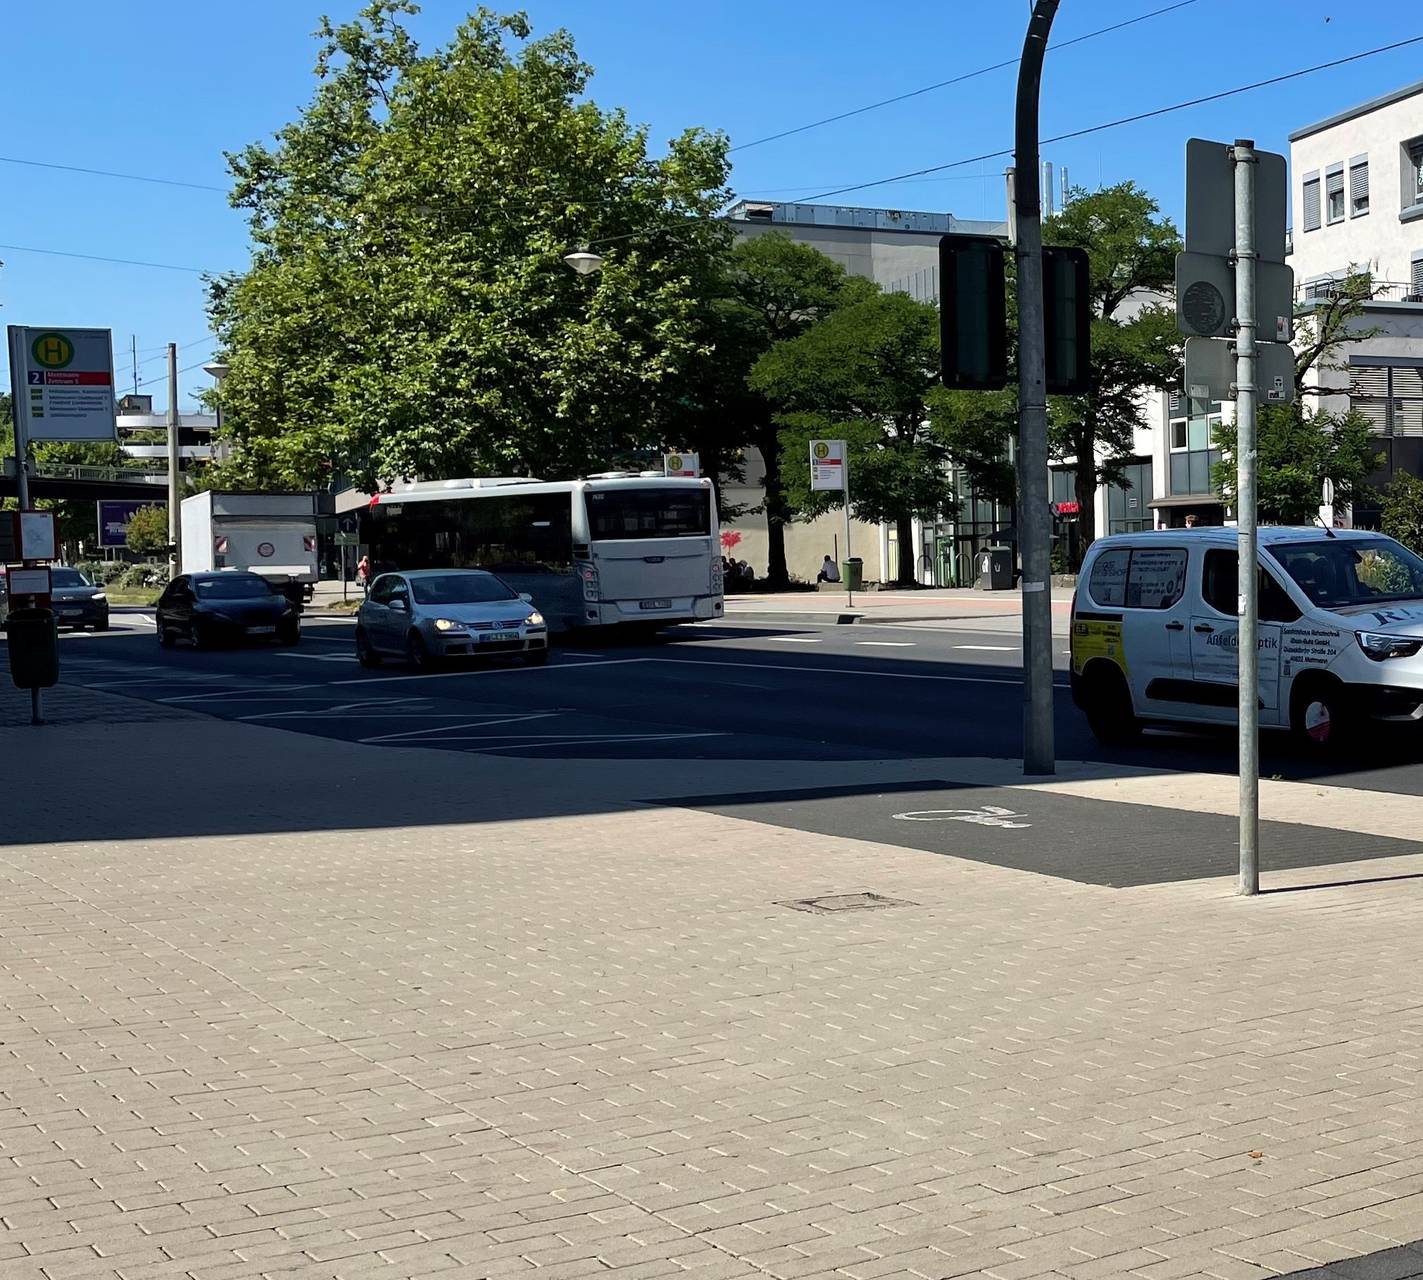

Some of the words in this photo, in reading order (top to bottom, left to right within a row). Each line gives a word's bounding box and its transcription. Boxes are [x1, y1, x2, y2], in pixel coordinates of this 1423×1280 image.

[45, 341, 62, 361] H
[31, 372, 40, 384] 2
[1206, 633, 1239, 647] Aßfeld
[1257, 637, 1278, 650] ptik
